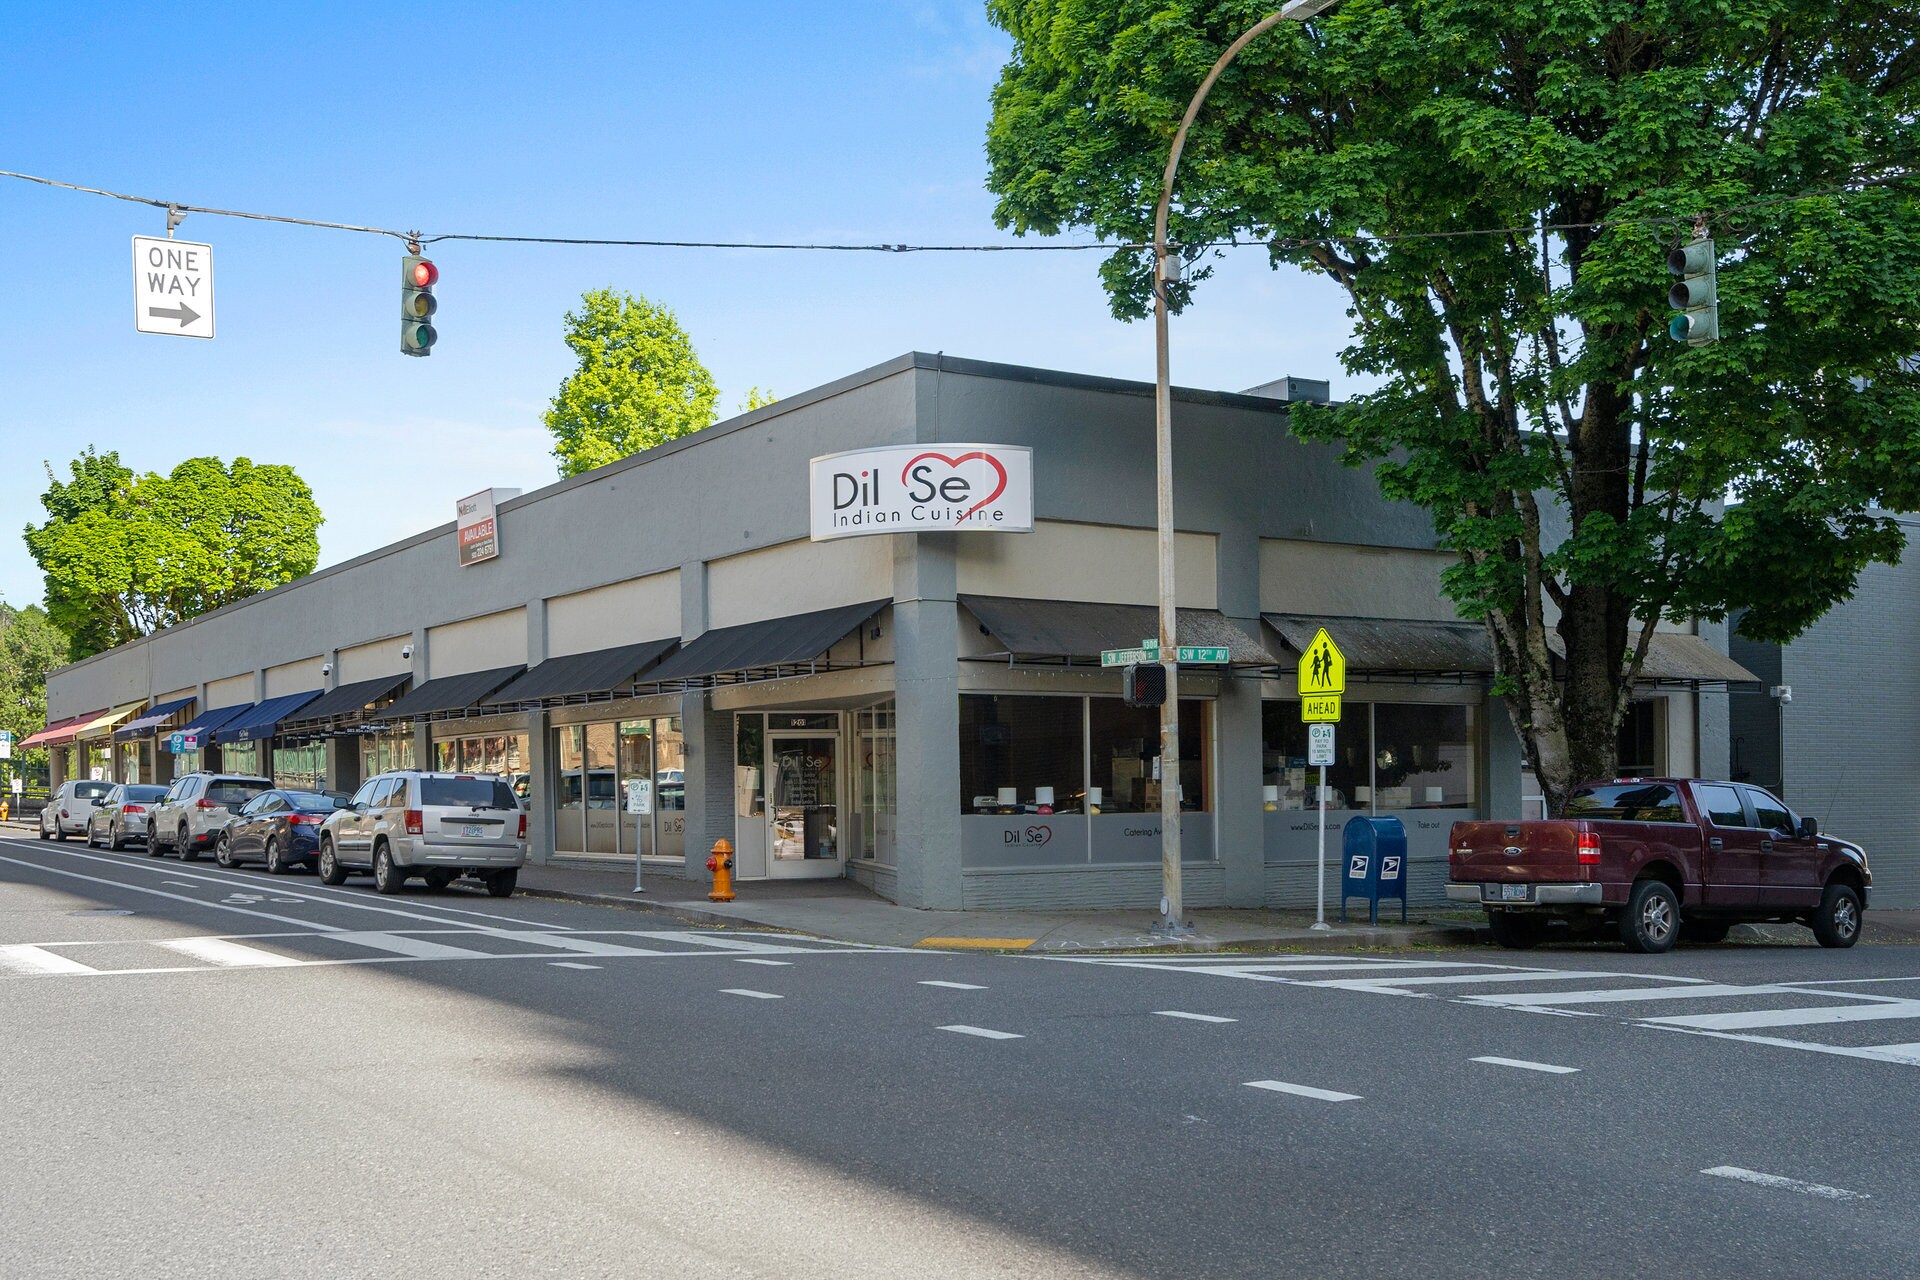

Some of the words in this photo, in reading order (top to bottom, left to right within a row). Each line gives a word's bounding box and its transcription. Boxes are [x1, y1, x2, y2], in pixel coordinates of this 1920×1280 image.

[149, 247, 199, 271] ONE
[148, 272, 201, 296] WAY
[833, 468, 879, 510] Dil
[909, 465, 971, 503] Se
[833, 509, 900, 527] Indian
[911, 505, 1004, 521] Cuisine
[464, 522, 493, 543] AVAILABLE
[1107, 653, 1116, 664] SW
[1117, 650, 1147, 663] JEFFERSON
[1182, 650, 1194, 660] SW
[1216, 650, 1226, 660] AV
[1307, 702, 1336, 714] AHEAD
[806, 755, 822, 767] Se
[1418, 821, 1430, 829] Take
[1004, 830, 1020, 844] Dil
[1026, 830, 1042, 843] Se
[1124, 828, 1152, 837] Catering
